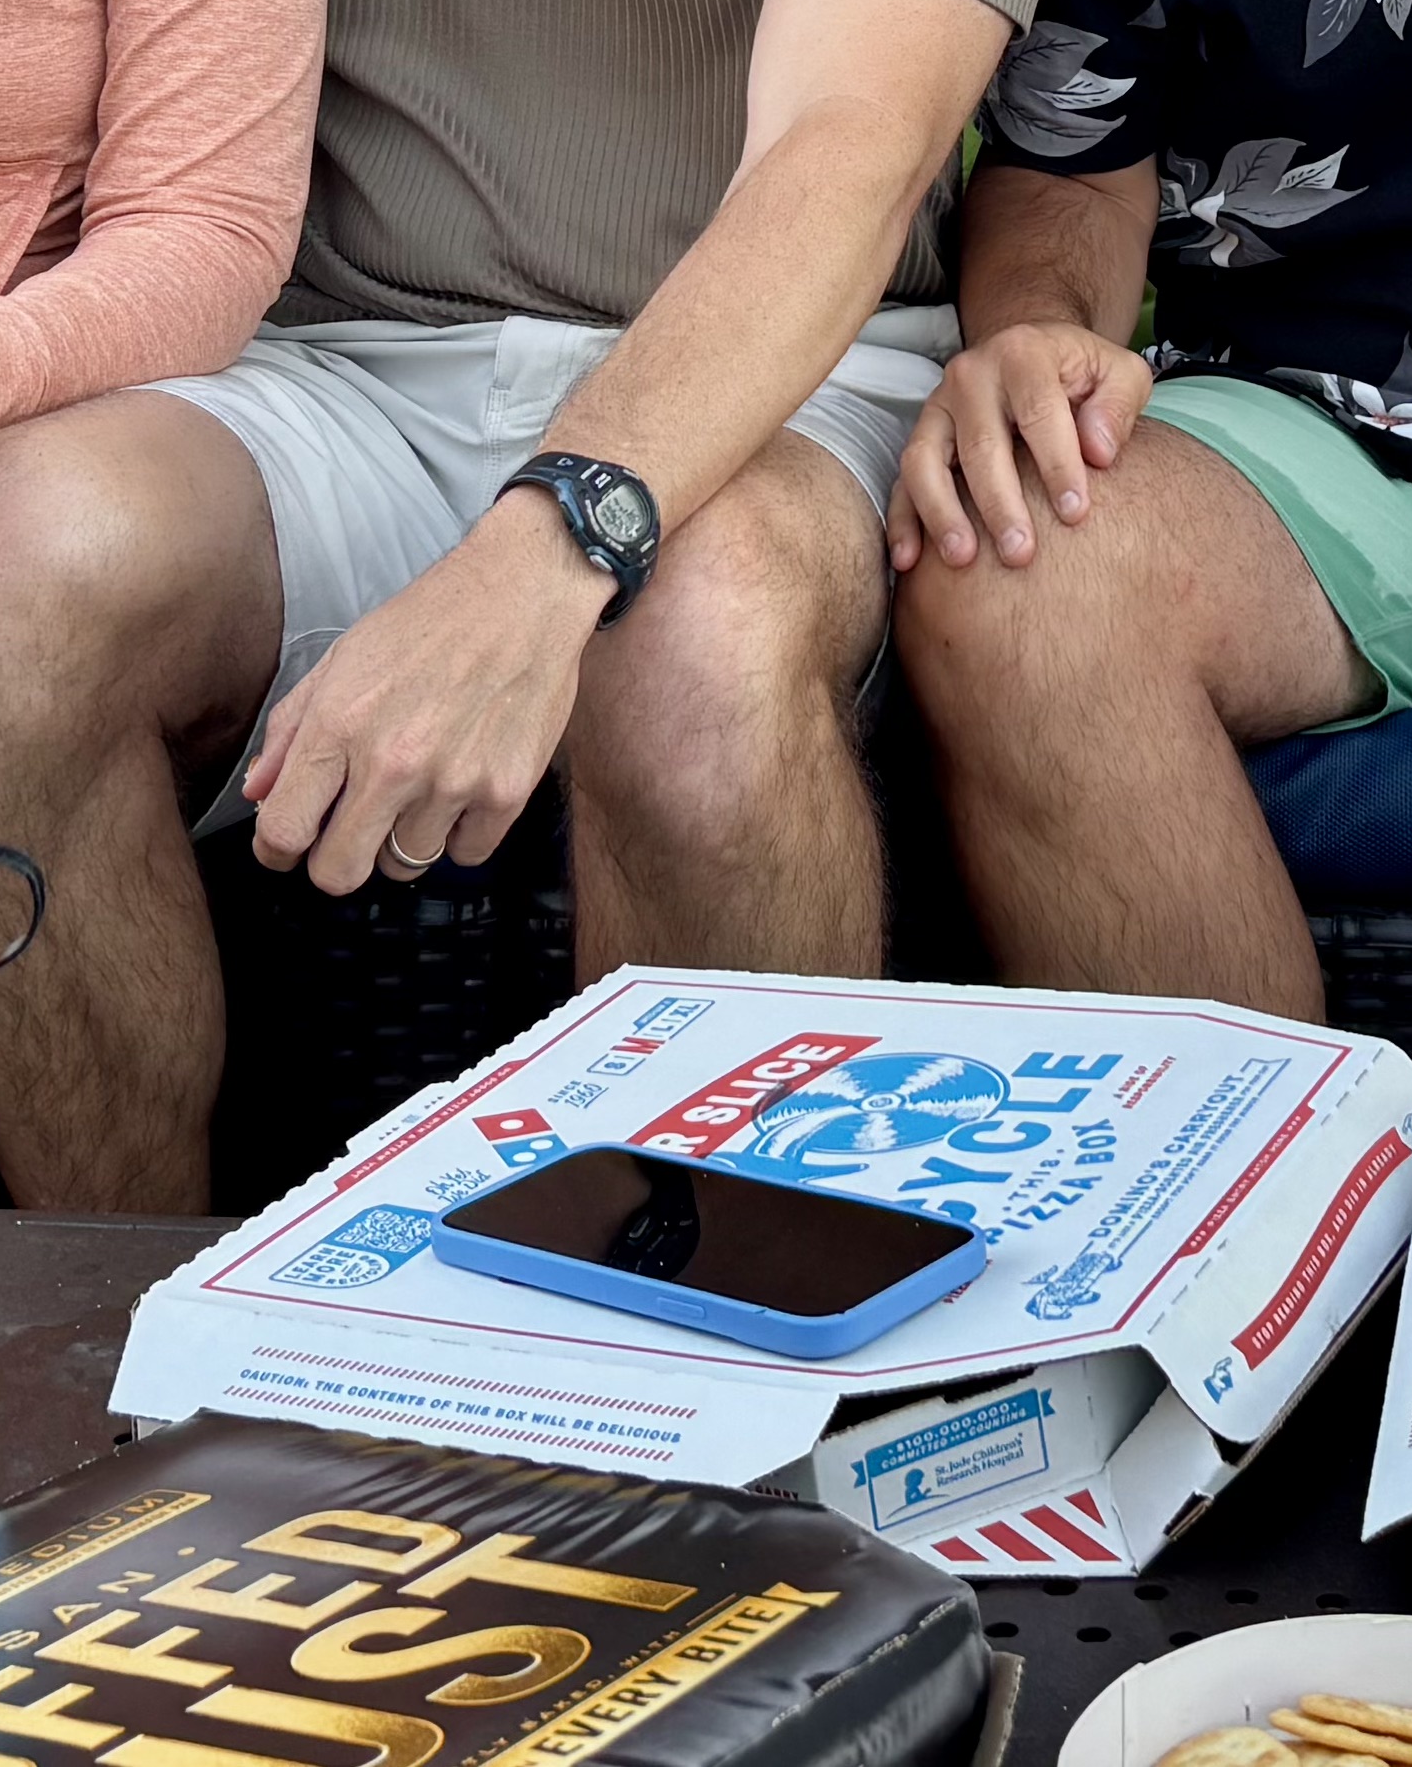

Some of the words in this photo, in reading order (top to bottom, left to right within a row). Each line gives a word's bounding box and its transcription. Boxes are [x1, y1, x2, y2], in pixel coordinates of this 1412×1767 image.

[564, 1083, 604, 1109] 1960
[681, 1042, 847, 1126] SLICE
[1087, 1159, 1172, 1238] DOMINO'S
[1163, 1074, 1245, 1155] CARRYOUT
[284, 1246, 337, 1280] LEARN
[302, 1250, 356, 1283] MORE
[240, 1368, 310, 1389] CAUTION:
[315, 1380, 344, 1395] THE
[347, 1385, 427, 1407] CONTENTS
[430, 1398, 453, 1410] OF
[456, 1401, 492, 1417] THIS
[495, 1408, 528, 1422] BOX
[531, 1413, 567, 1428] WILL
[572, 1419, 594, 1432] BE
[597, 1422, 682, 1444] DELICIOUS
[94, 1533, 698, 1767] UST
[537, 1670, 683, 1756] EVERY
[676, 1605, 785, 1664] BITE
